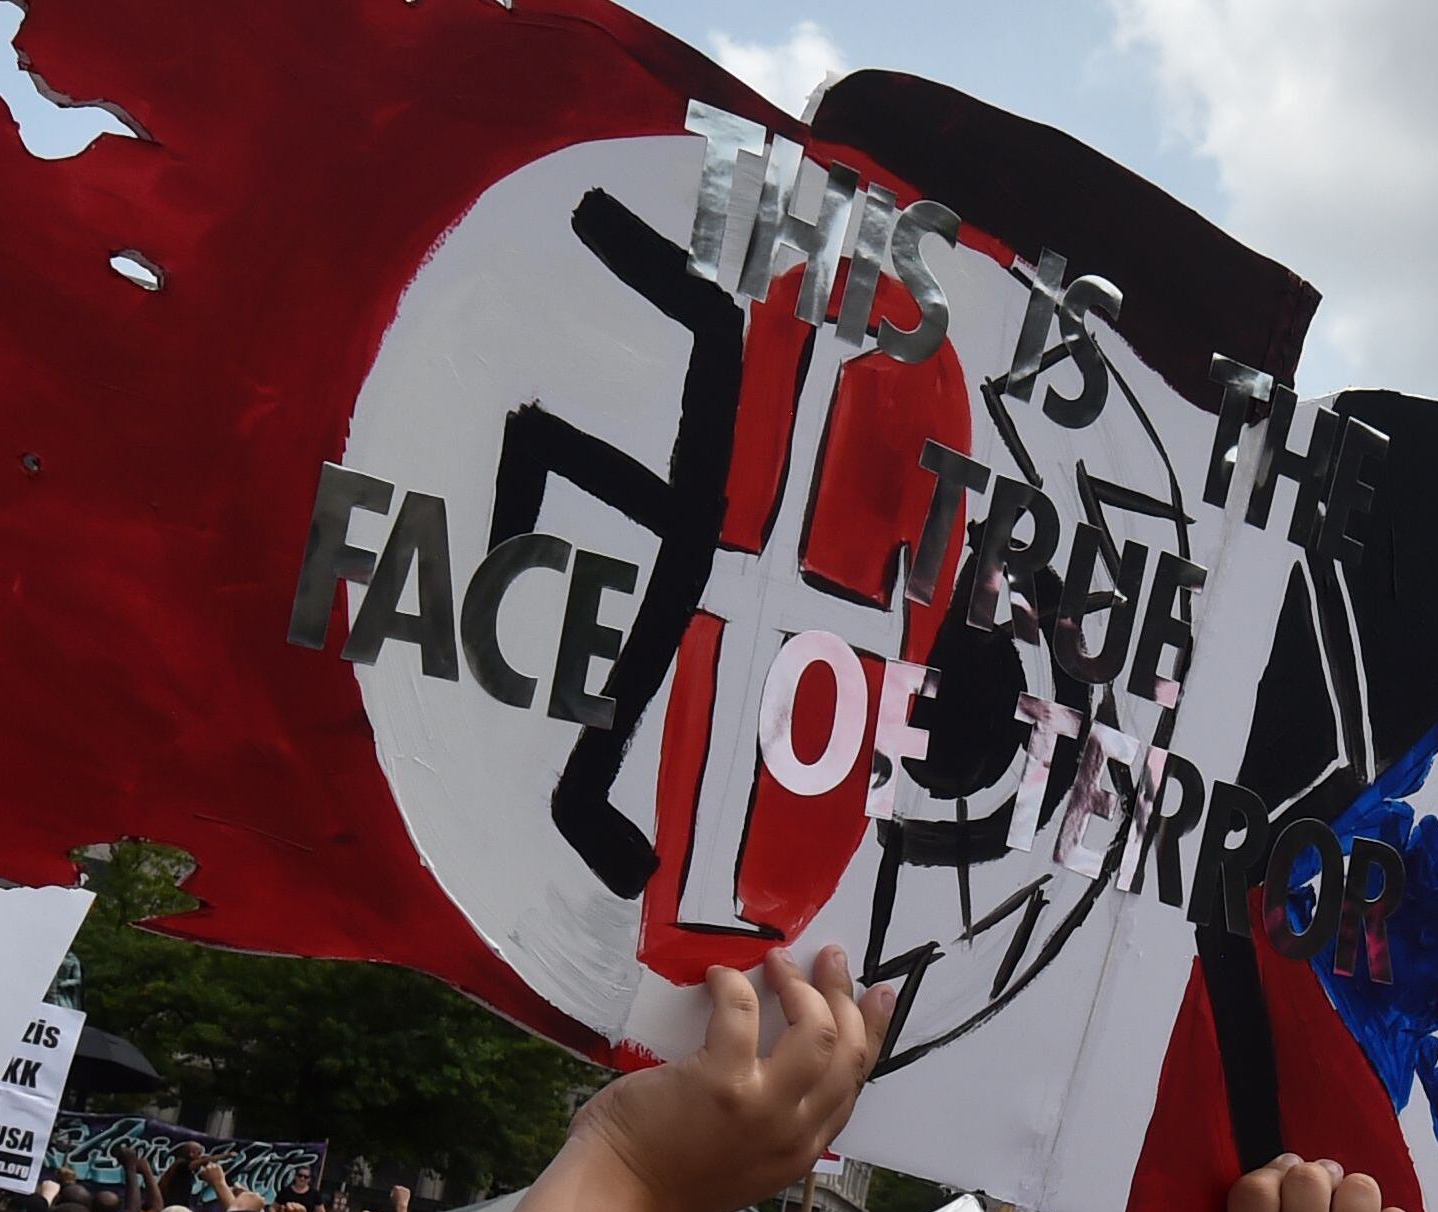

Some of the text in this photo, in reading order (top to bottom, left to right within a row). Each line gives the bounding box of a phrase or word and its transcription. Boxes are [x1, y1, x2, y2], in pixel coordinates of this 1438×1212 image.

[685, 98, 1391, 558] THIS IS THE
[905, 438, 1208, 709] TRUE
[287, 462, 1406, 985] FACE OF TERROR
[1, 1057, 43, 1088] KK
[21, 1018, 61, 1049] zis
